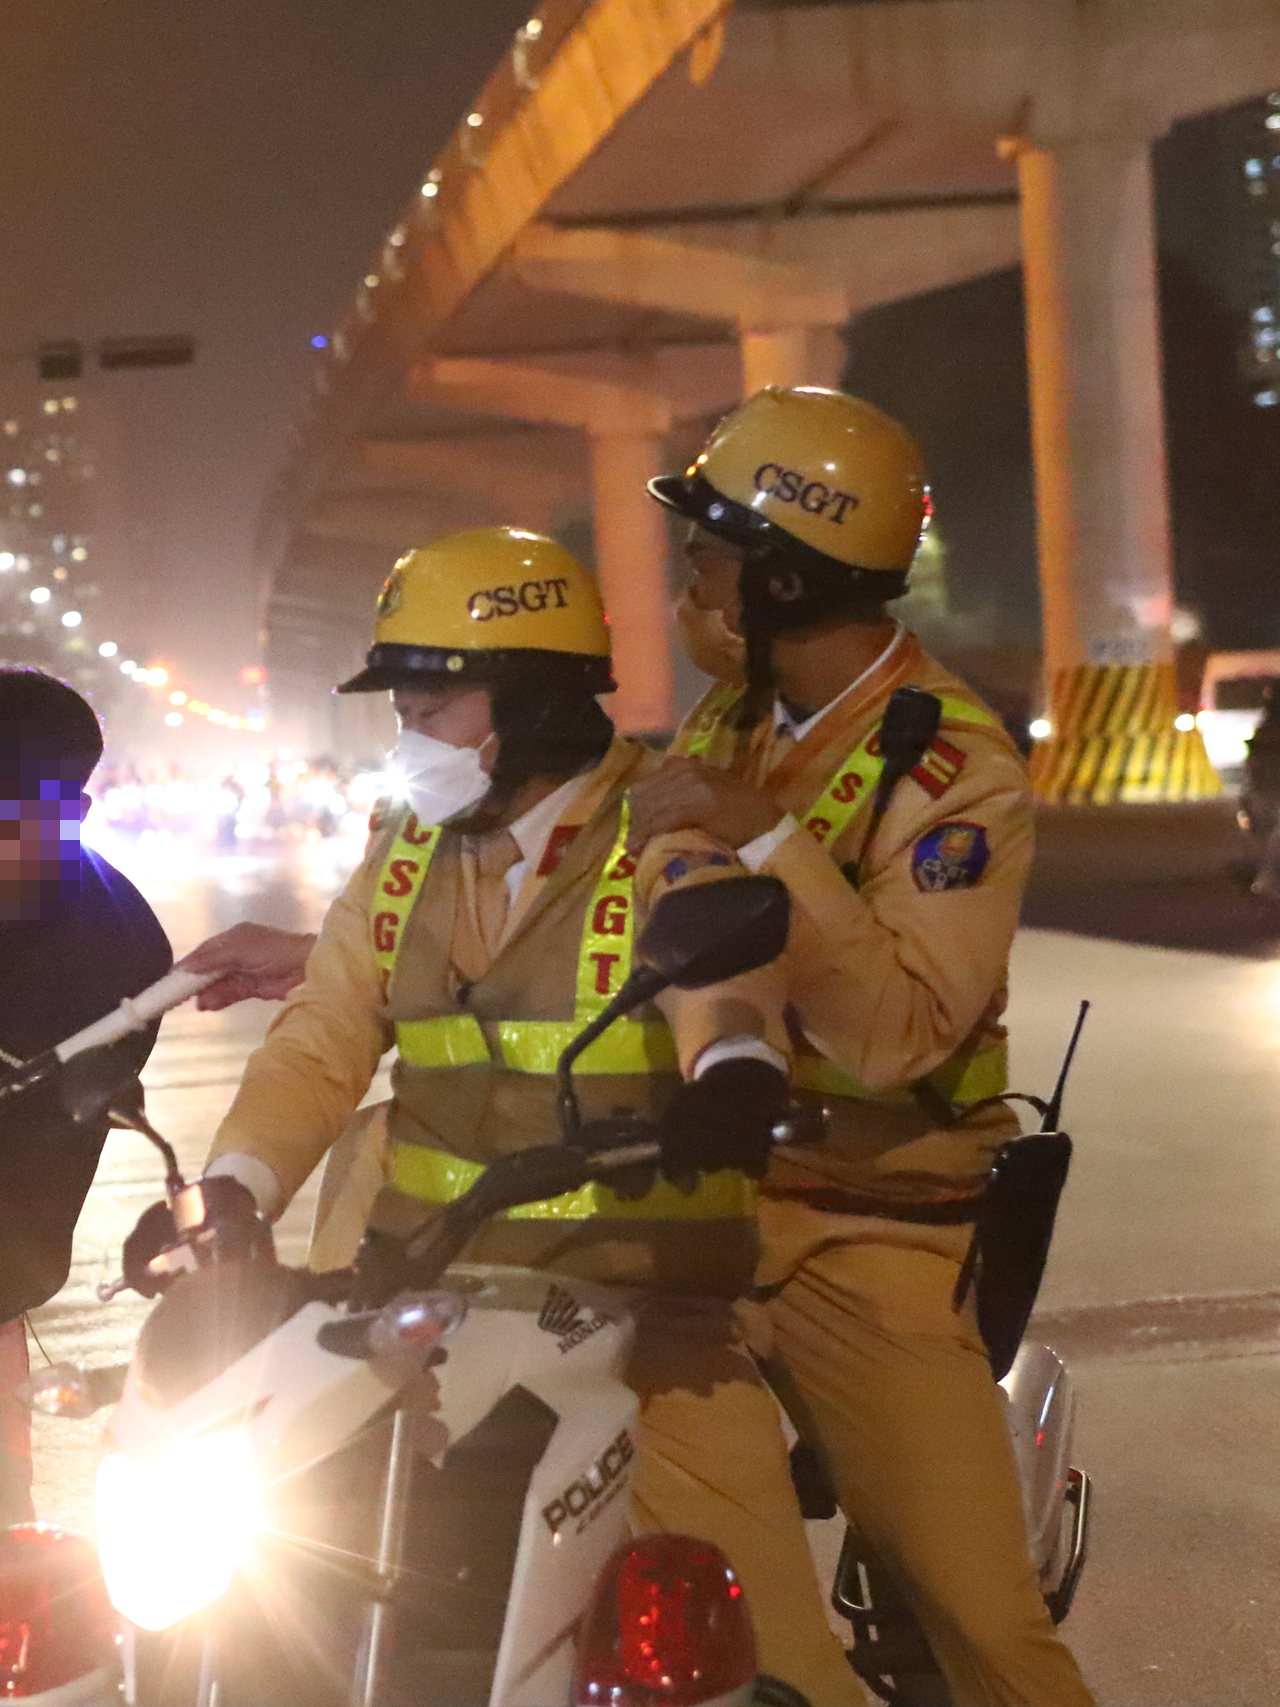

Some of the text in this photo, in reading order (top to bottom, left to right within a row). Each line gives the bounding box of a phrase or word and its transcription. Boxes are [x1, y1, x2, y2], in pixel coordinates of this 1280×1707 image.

[752, 462, 860, 527] CSGT
[466, 577, 570, 622] CSGT
[542, 1427, 635, 1535] POLICE
